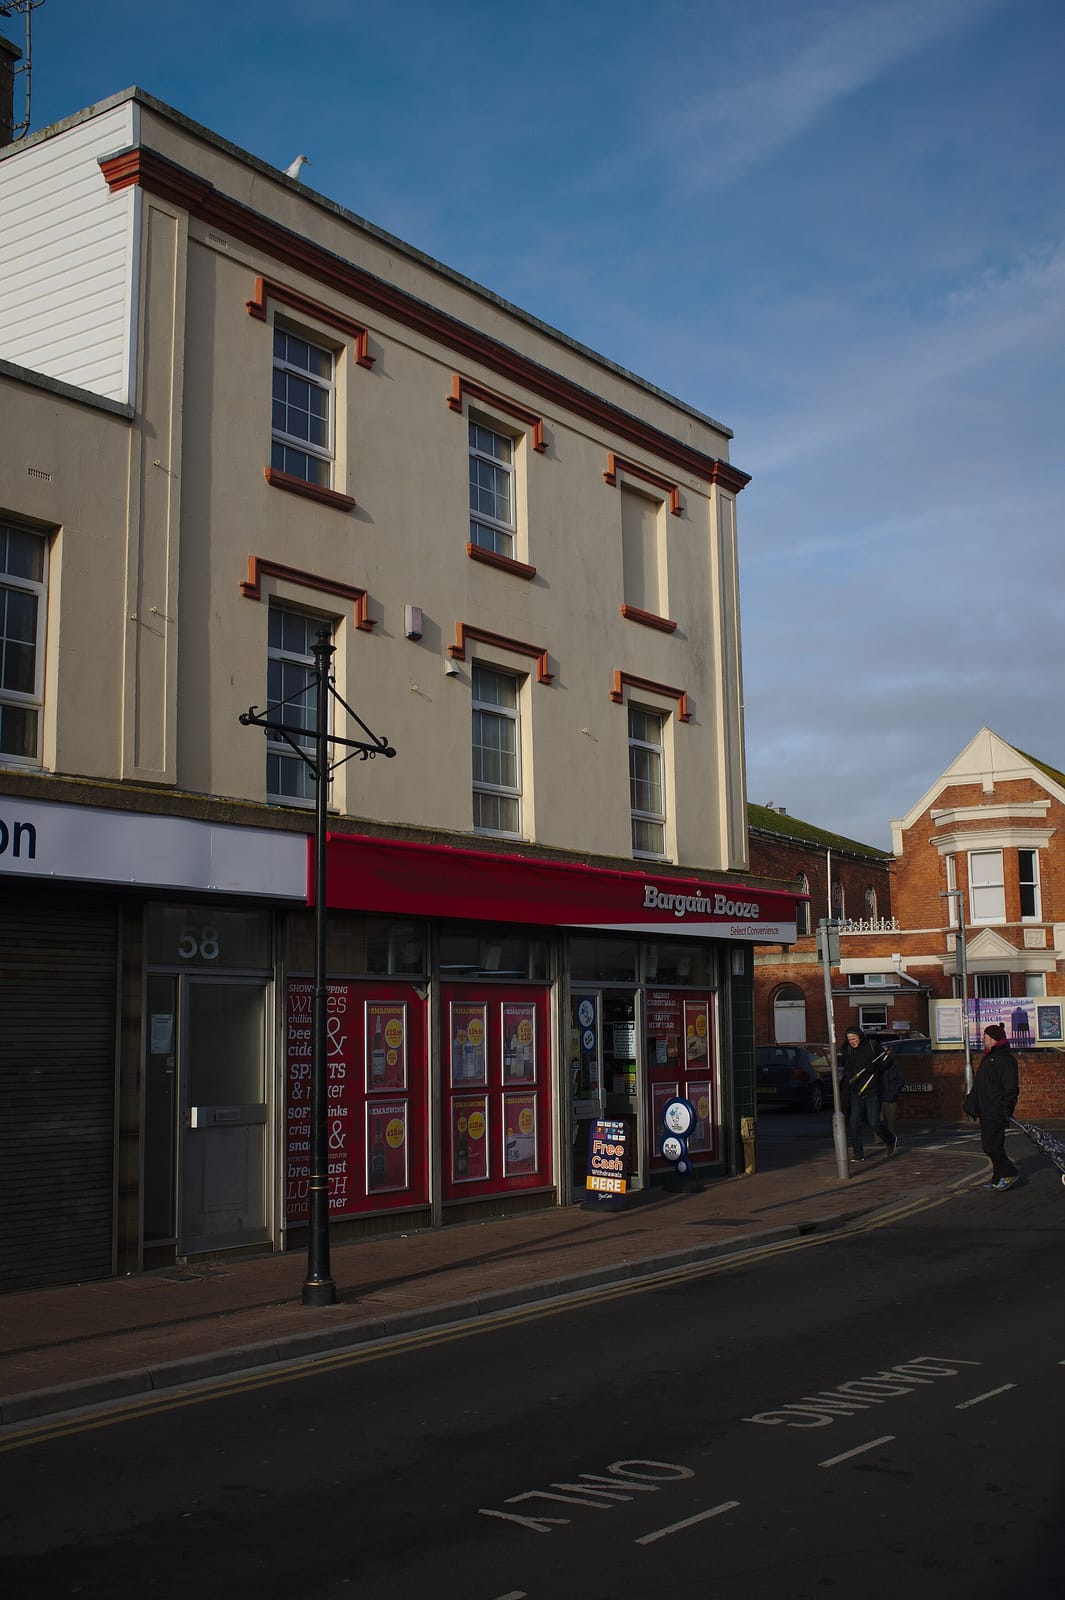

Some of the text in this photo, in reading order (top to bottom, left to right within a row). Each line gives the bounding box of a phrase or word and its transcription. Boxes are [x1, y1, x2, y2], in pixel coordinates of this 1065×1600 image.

[643, 885, 760, 919] Bargain Booze
[730, 926, 779, 937] Select Convenience
[177, 925, 220, 961] 58
[328, 1119, 347, 1149] &
[592, 1139, 625, 1157] Free
[591, 1155, 624, 1171] Cash
[591, 1176, 622, 1192] HERE
[288, 1198, 309, 1214] and
[478, 1355, 983, 1534] LOADING ONLY
